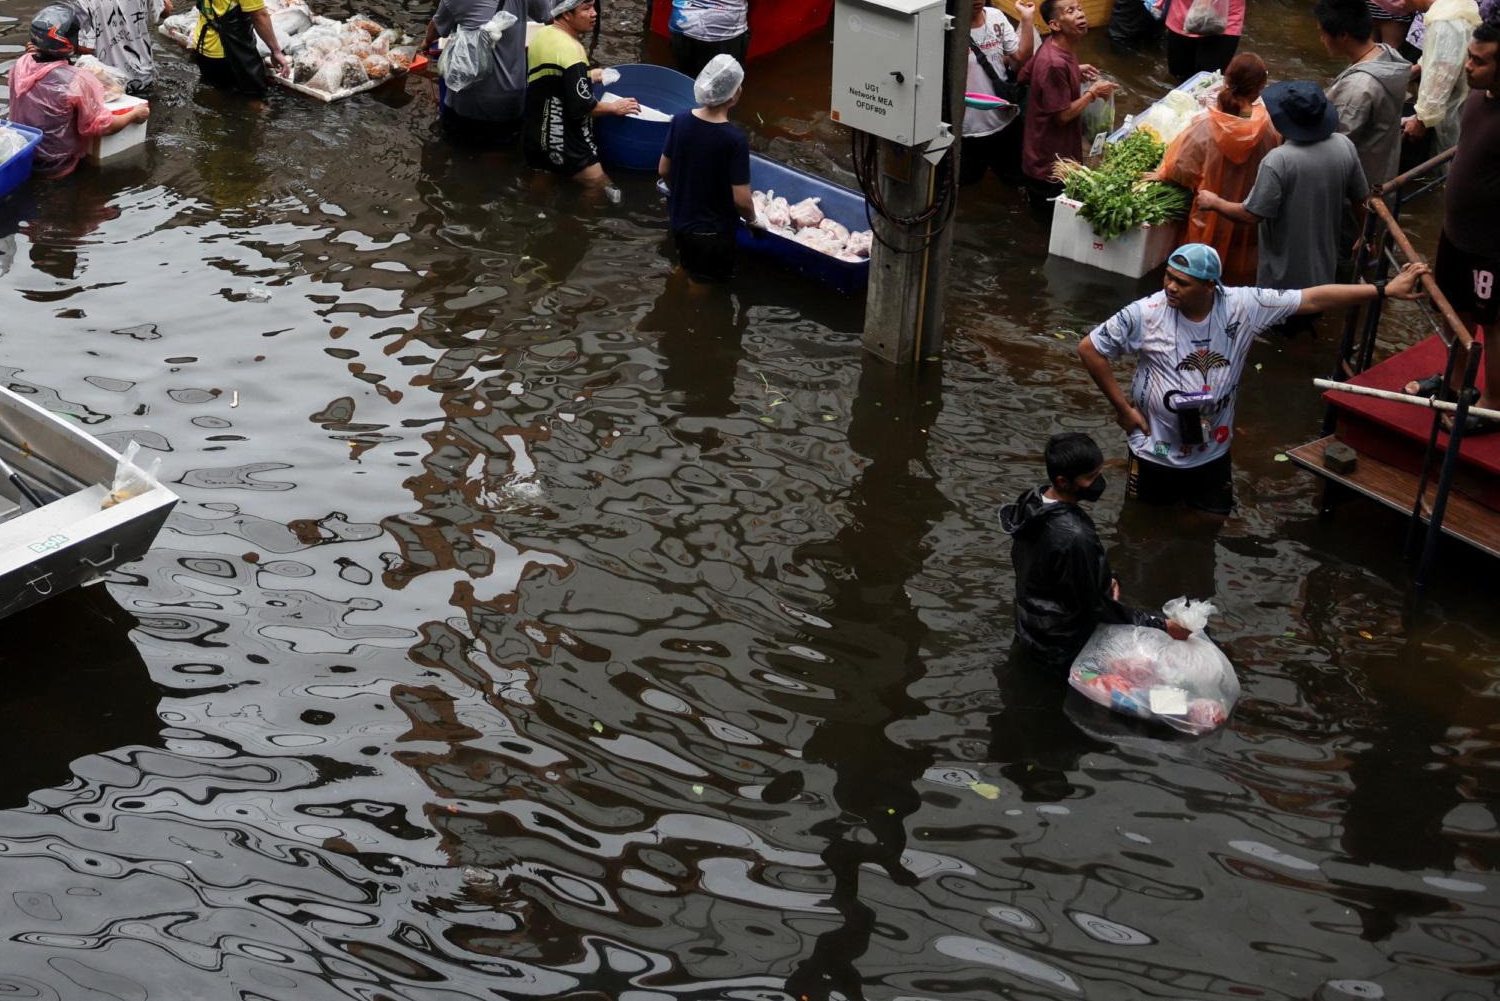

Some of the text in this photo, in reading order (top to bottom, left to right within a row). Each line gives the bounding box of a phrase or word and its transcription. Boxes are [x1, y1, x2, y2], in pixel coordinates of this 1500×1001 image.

[849, 87, 894, 107] Network MEA
[864, 82, 879, 93] UG1
[1472, 269, 1494, 299] 18
